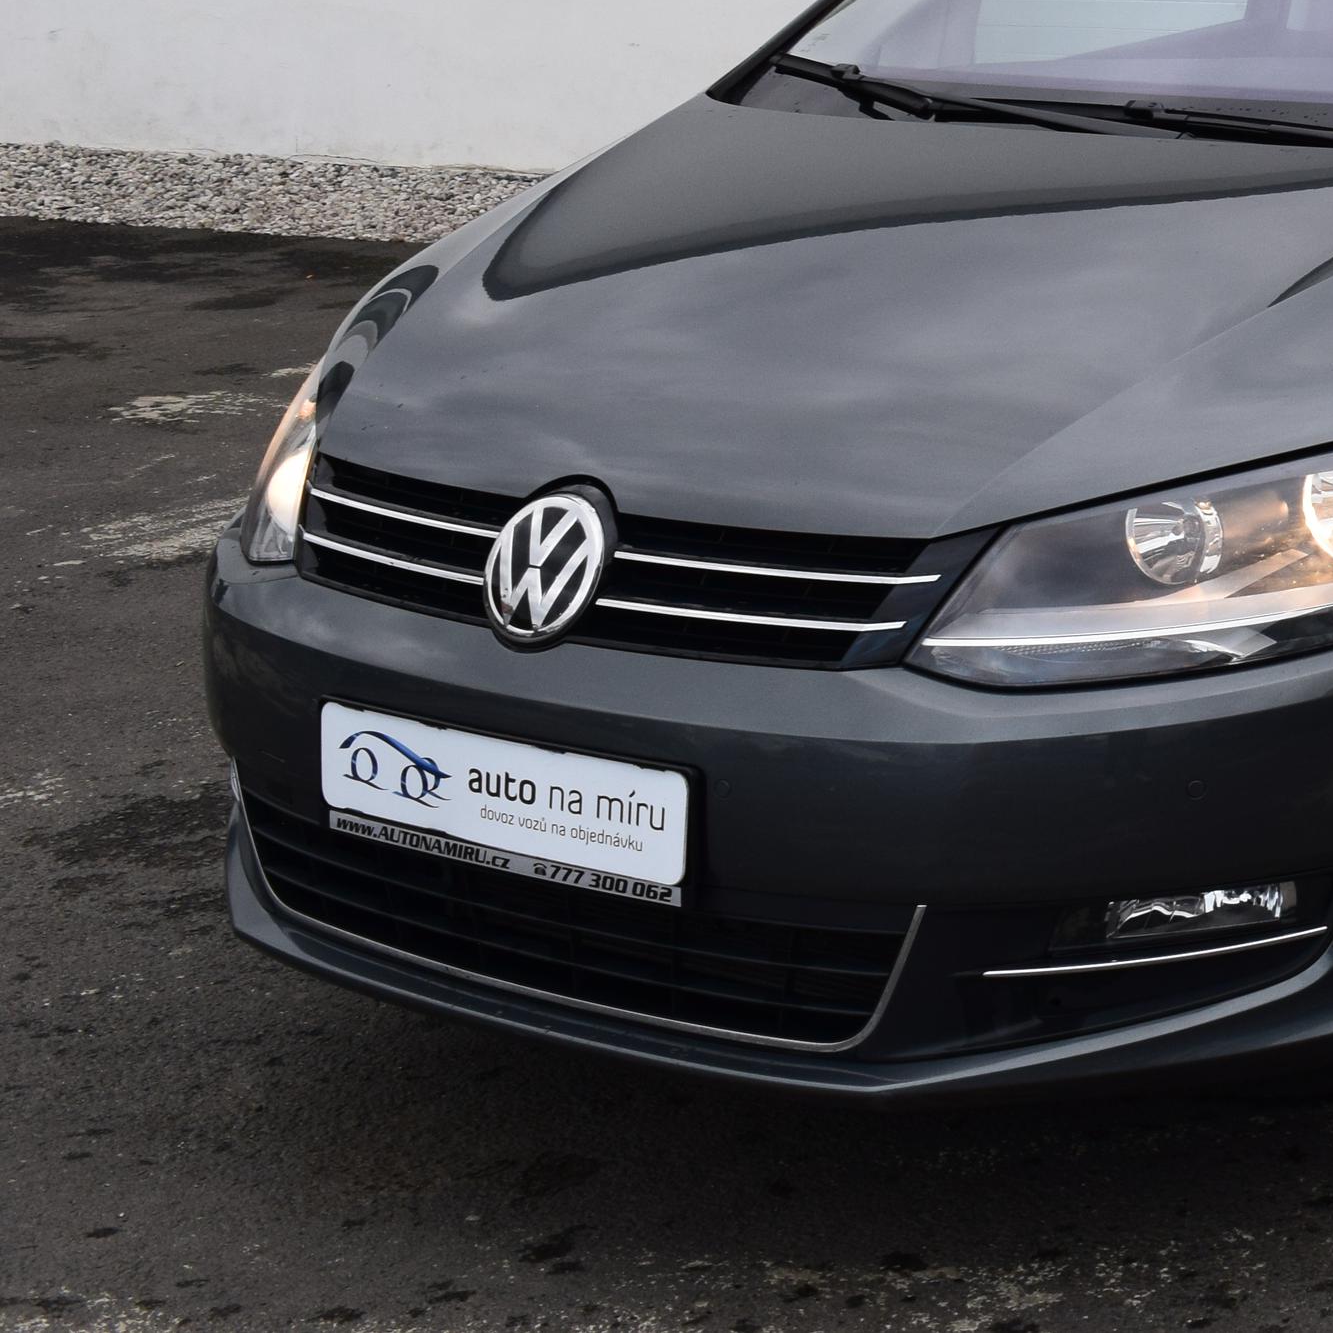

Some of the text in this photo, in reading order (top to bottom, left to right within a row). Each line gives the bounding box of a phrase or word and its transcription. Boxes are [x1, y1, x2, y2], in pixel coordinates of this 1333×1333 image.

[488, 495, 602, 635] VW
[468, 768, 665, 831] auto na míru
[480, 804, 643, 852] dovoz vozů na objednávku
[336, 817, 673, 903] www.AUTONAMIRU.cz 777 300 062
